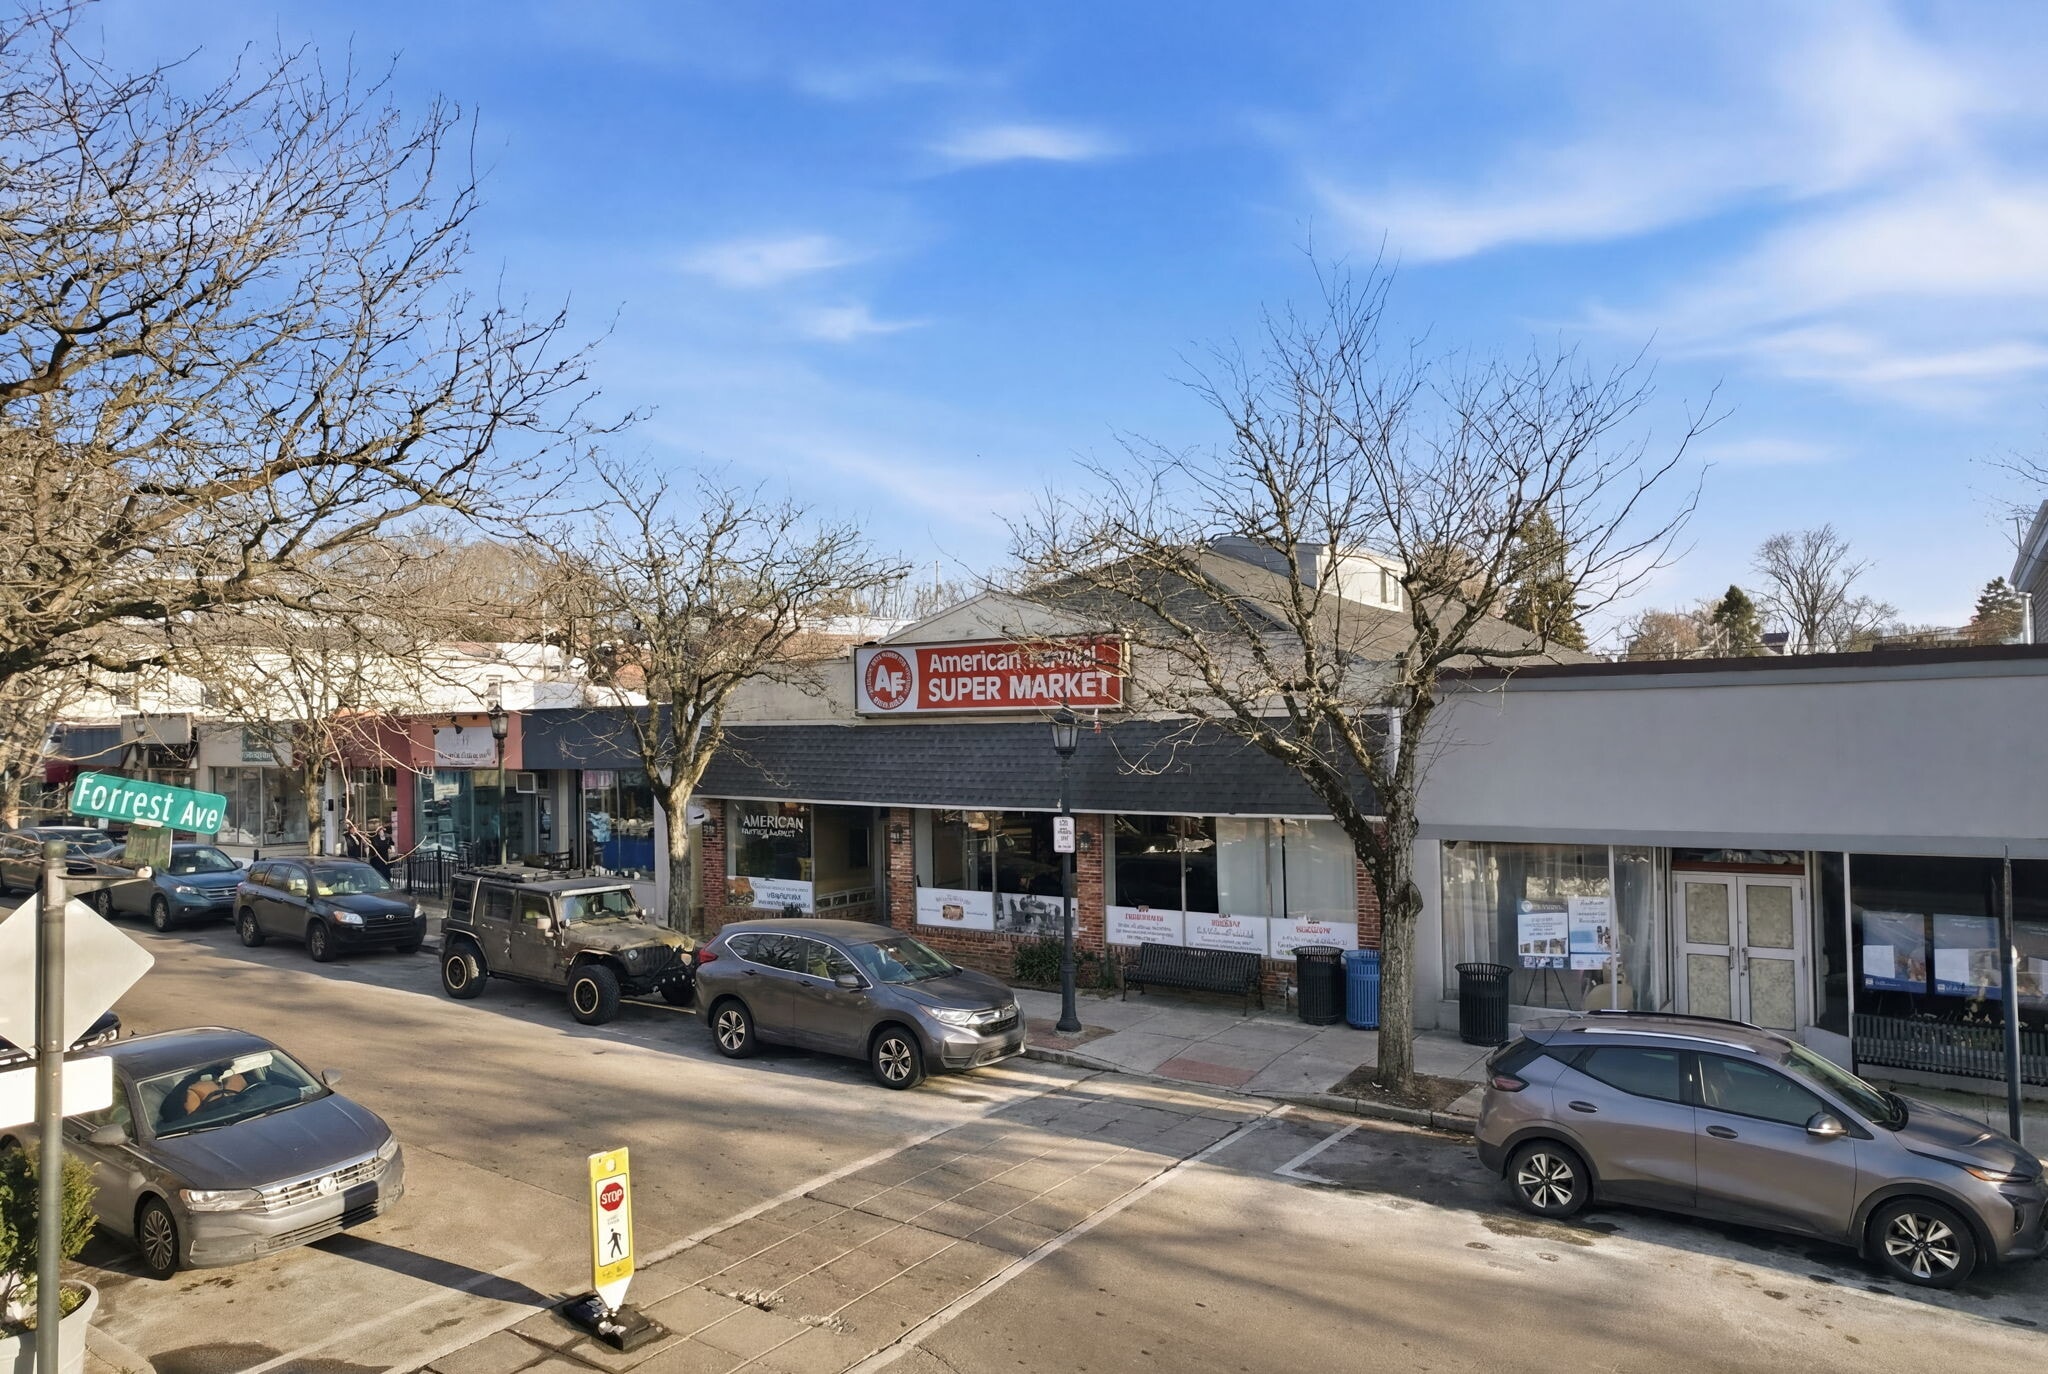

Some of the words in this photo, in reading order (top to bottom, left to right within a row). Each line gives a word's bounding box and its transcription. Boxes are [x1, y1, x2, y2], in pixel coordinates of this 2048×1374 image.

[929, 649, 1021, 672] American
[928, 675, 1002, 702] SUPER
[1009, 670, 1112, 699] MARKET
[76, 778, 174, 822] Forrest
[179, 800, 218, 830] Ave
[743, 814, 804, 829] AMERICAN
